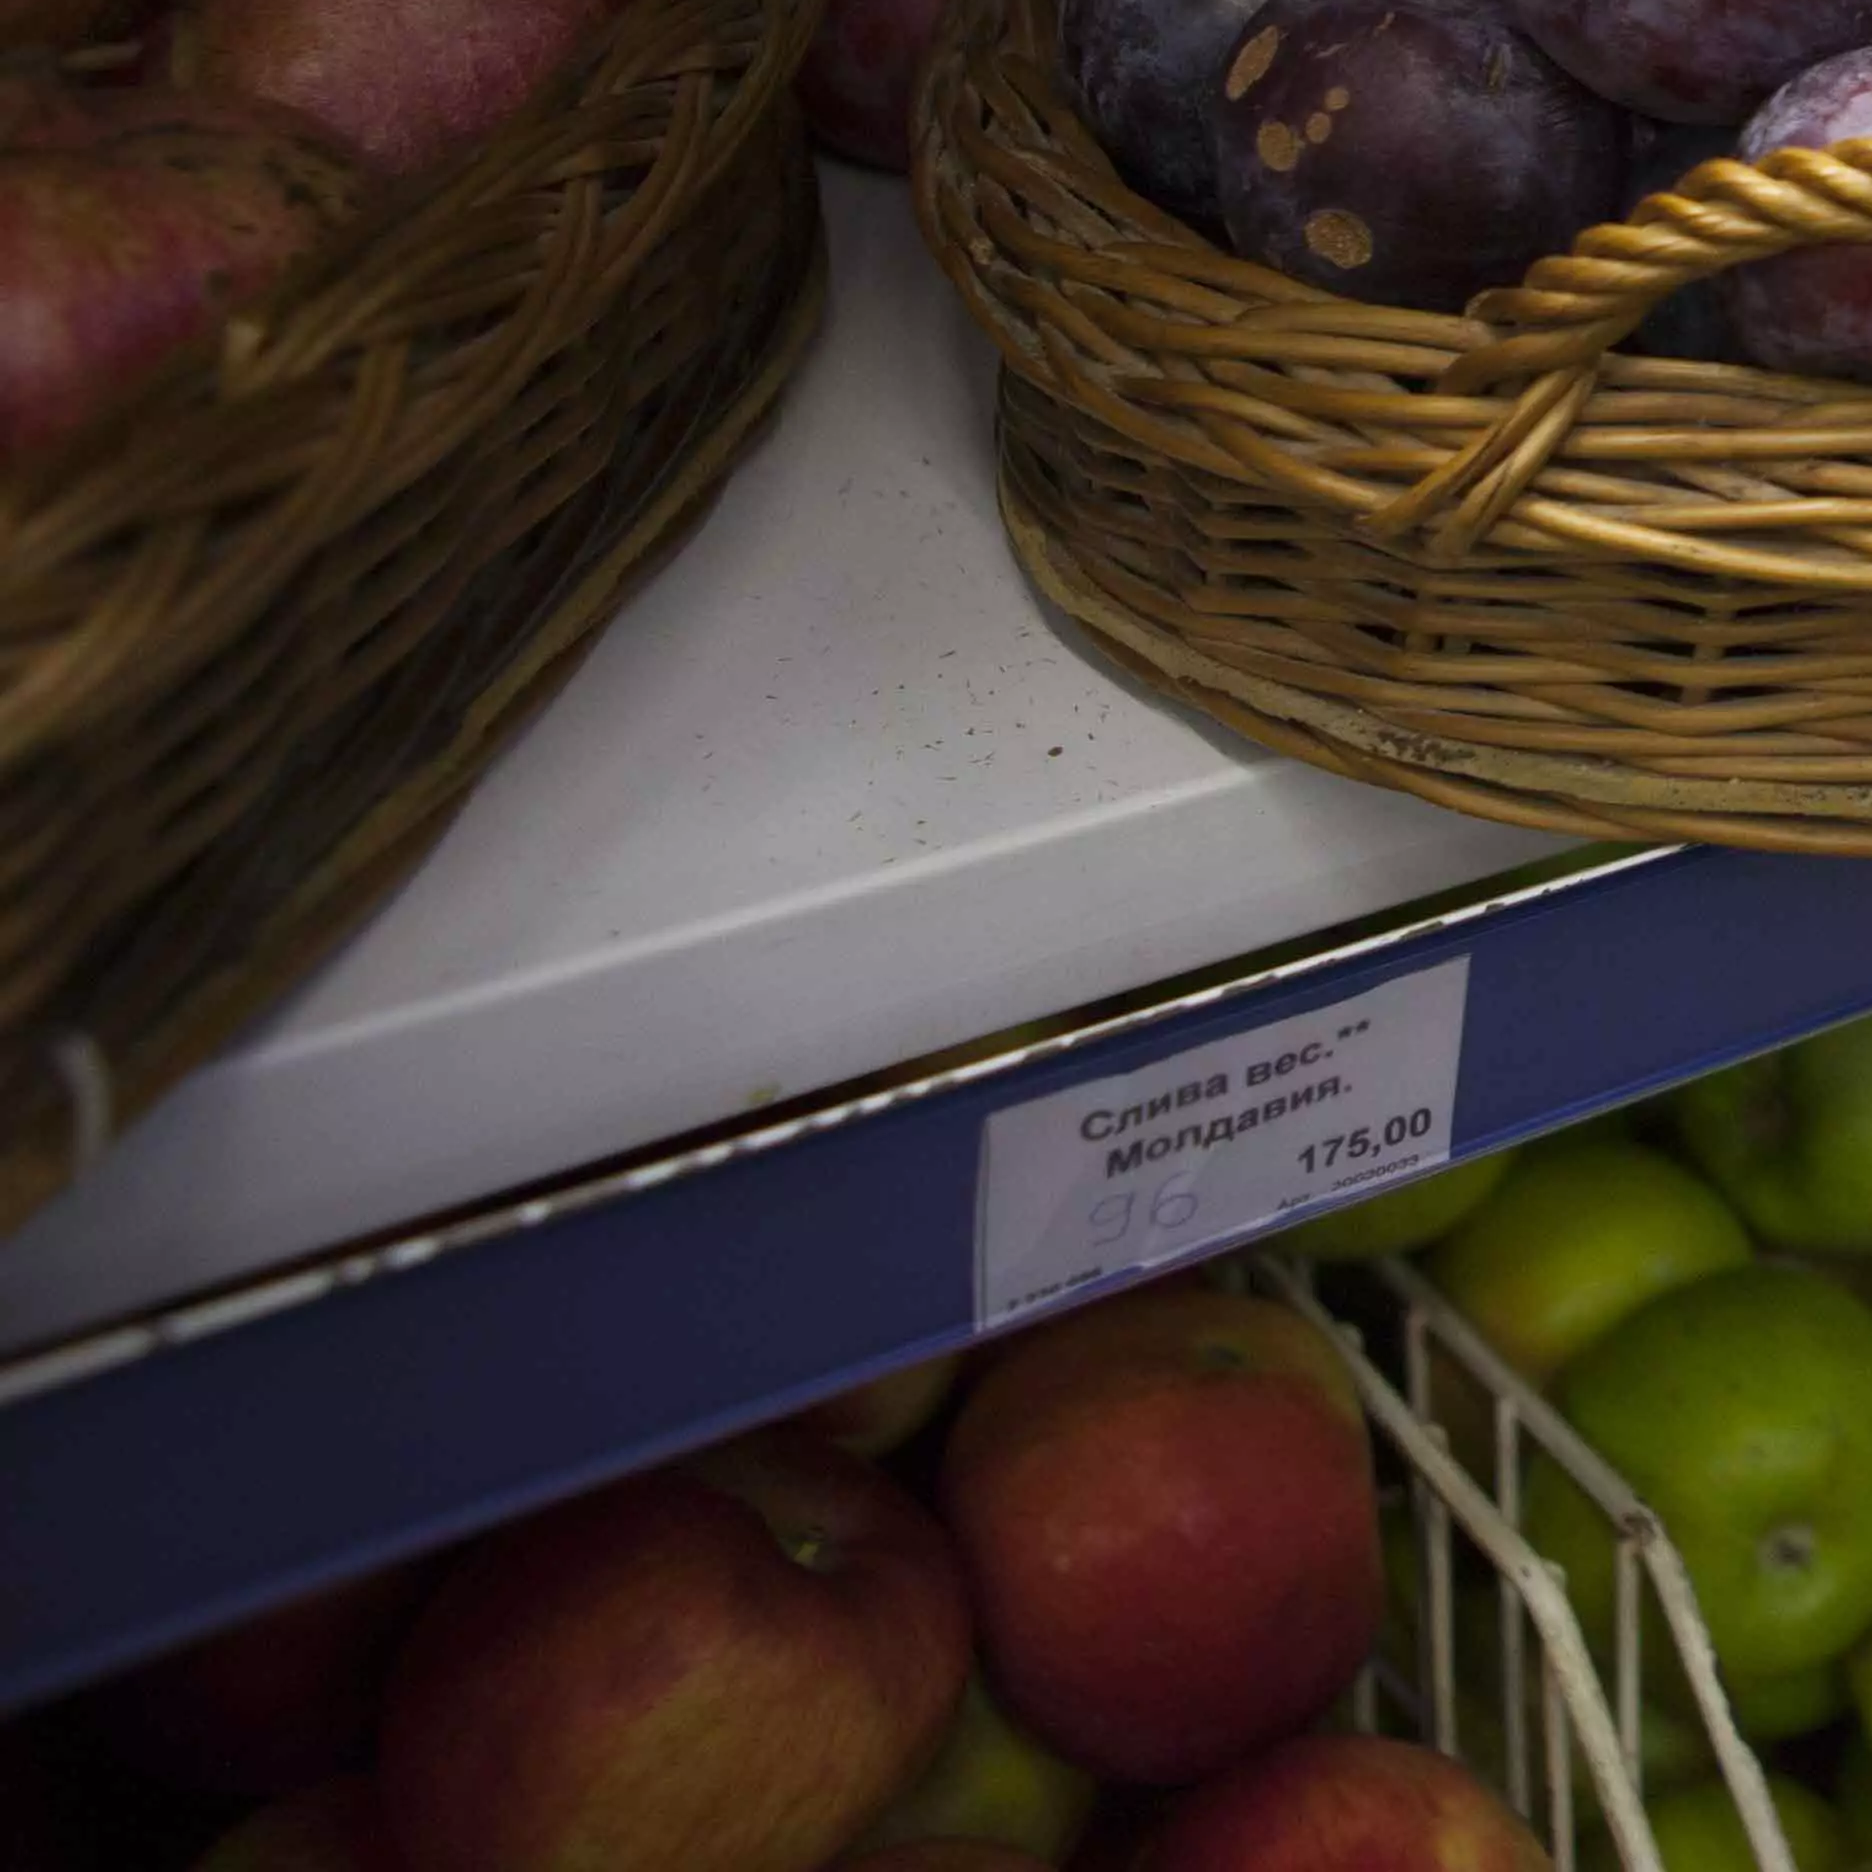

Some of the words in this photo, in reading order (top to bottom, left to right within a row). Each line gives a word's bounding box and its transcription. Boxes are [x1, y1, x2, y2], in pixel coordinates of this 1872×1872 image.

[1080, 1071, 1230, 1144] Слива
[1105, 1073, 1353, 1178] Молдавия.
[1296, 1107, 1433, 1174] 175,00
